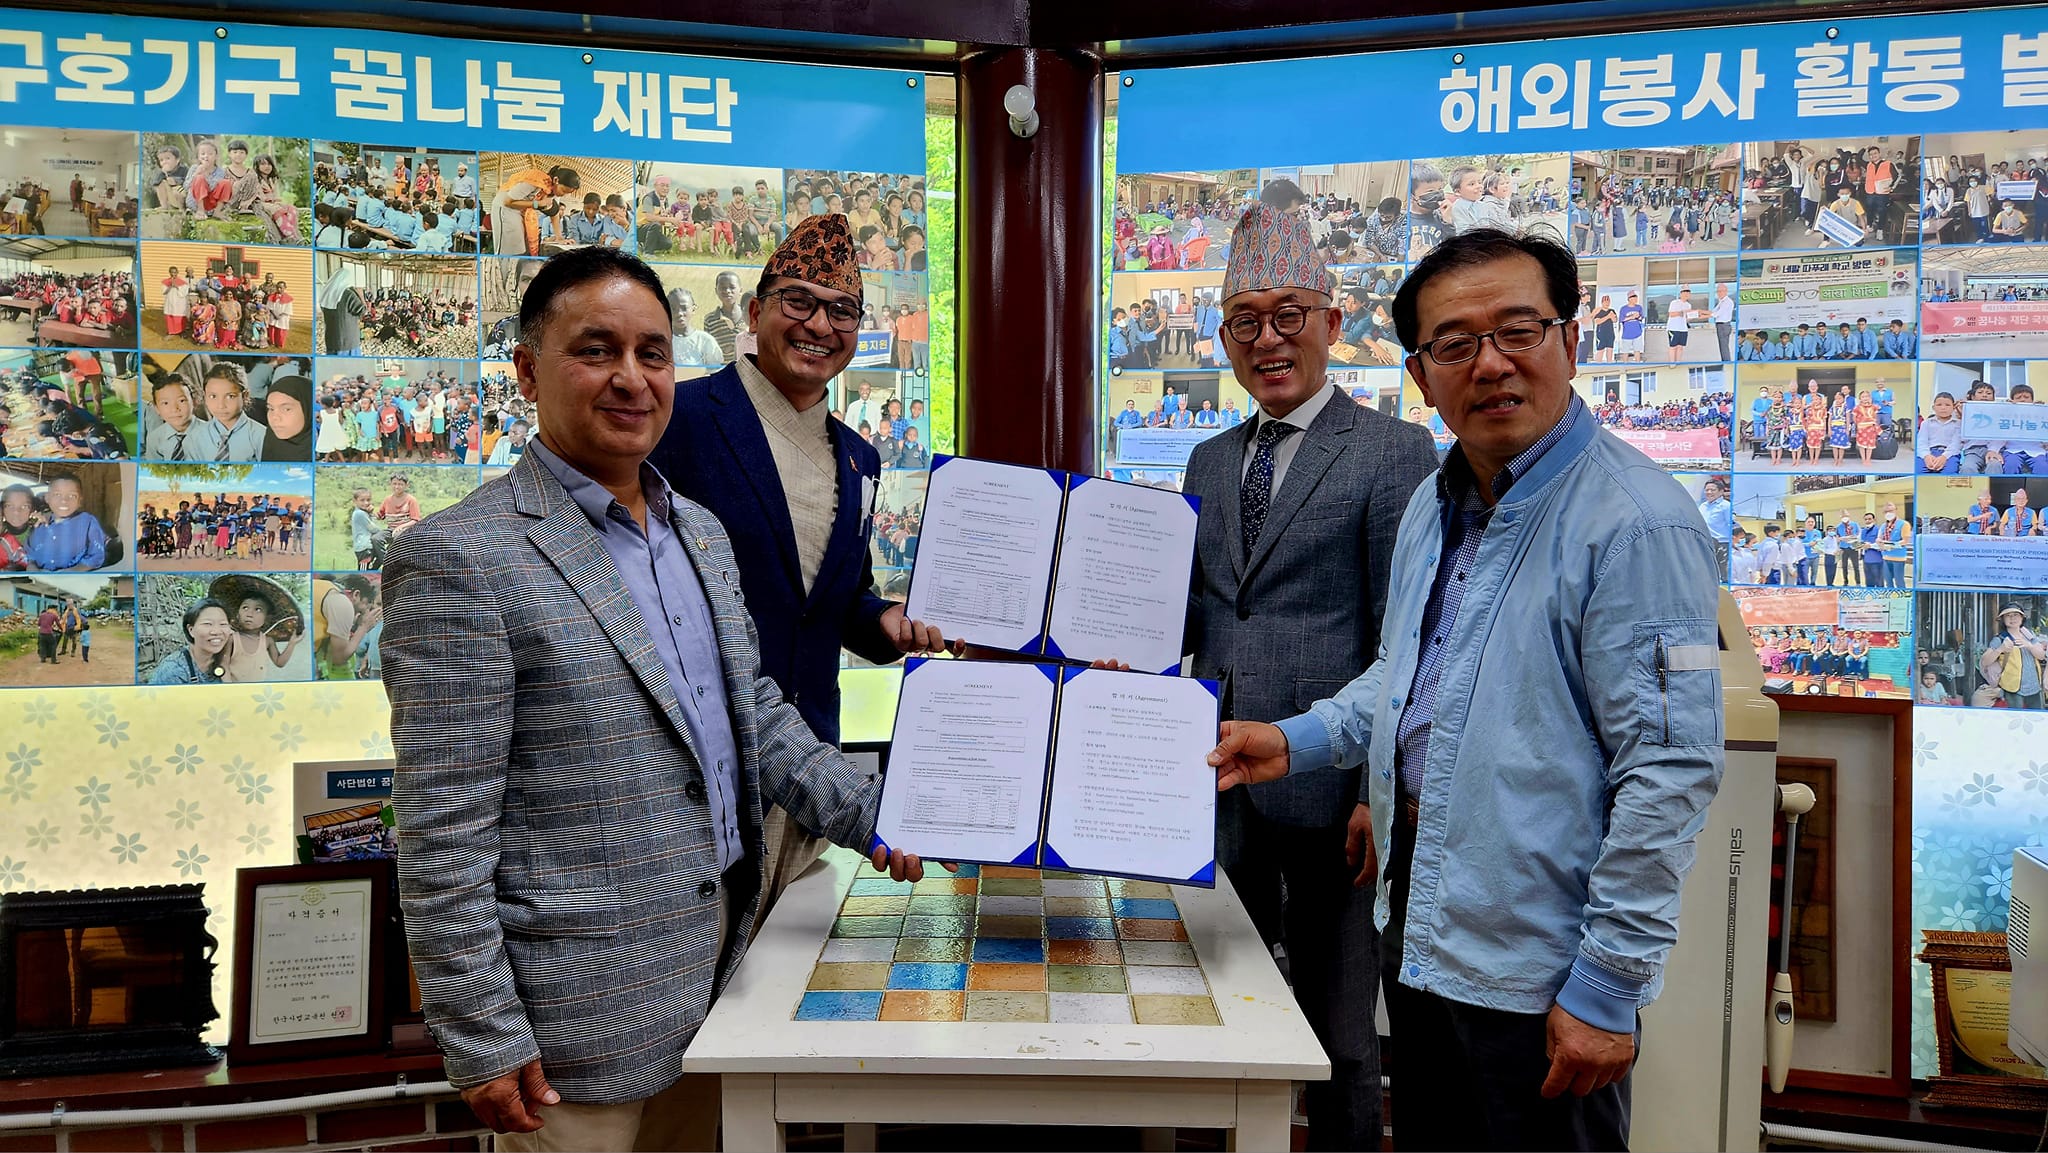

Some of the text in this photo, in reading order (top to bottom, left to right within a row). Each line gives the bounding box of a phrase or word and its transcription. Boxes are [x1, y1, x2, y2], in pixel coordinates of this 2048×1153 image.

[0, 29, 738, 144] 구호기구 꿈나눔 재단
[1439, 48, 1765, 134] 해외봉사
[1794, 35, 1965, 117] 활동
[1832, 261, 1850, 271] 학교
[1852, 259, 1872, 269] 방문
[1751, 290, 1784, 300] Camp
[1999, 418, 2039, 431] 꿈나눔
[337, 777, 377, 789] 사단법인
[1729, 828, 1745, 876] salus
[1724, 885, 1736, 1022] BODY COMPOSITION ANALYZER
